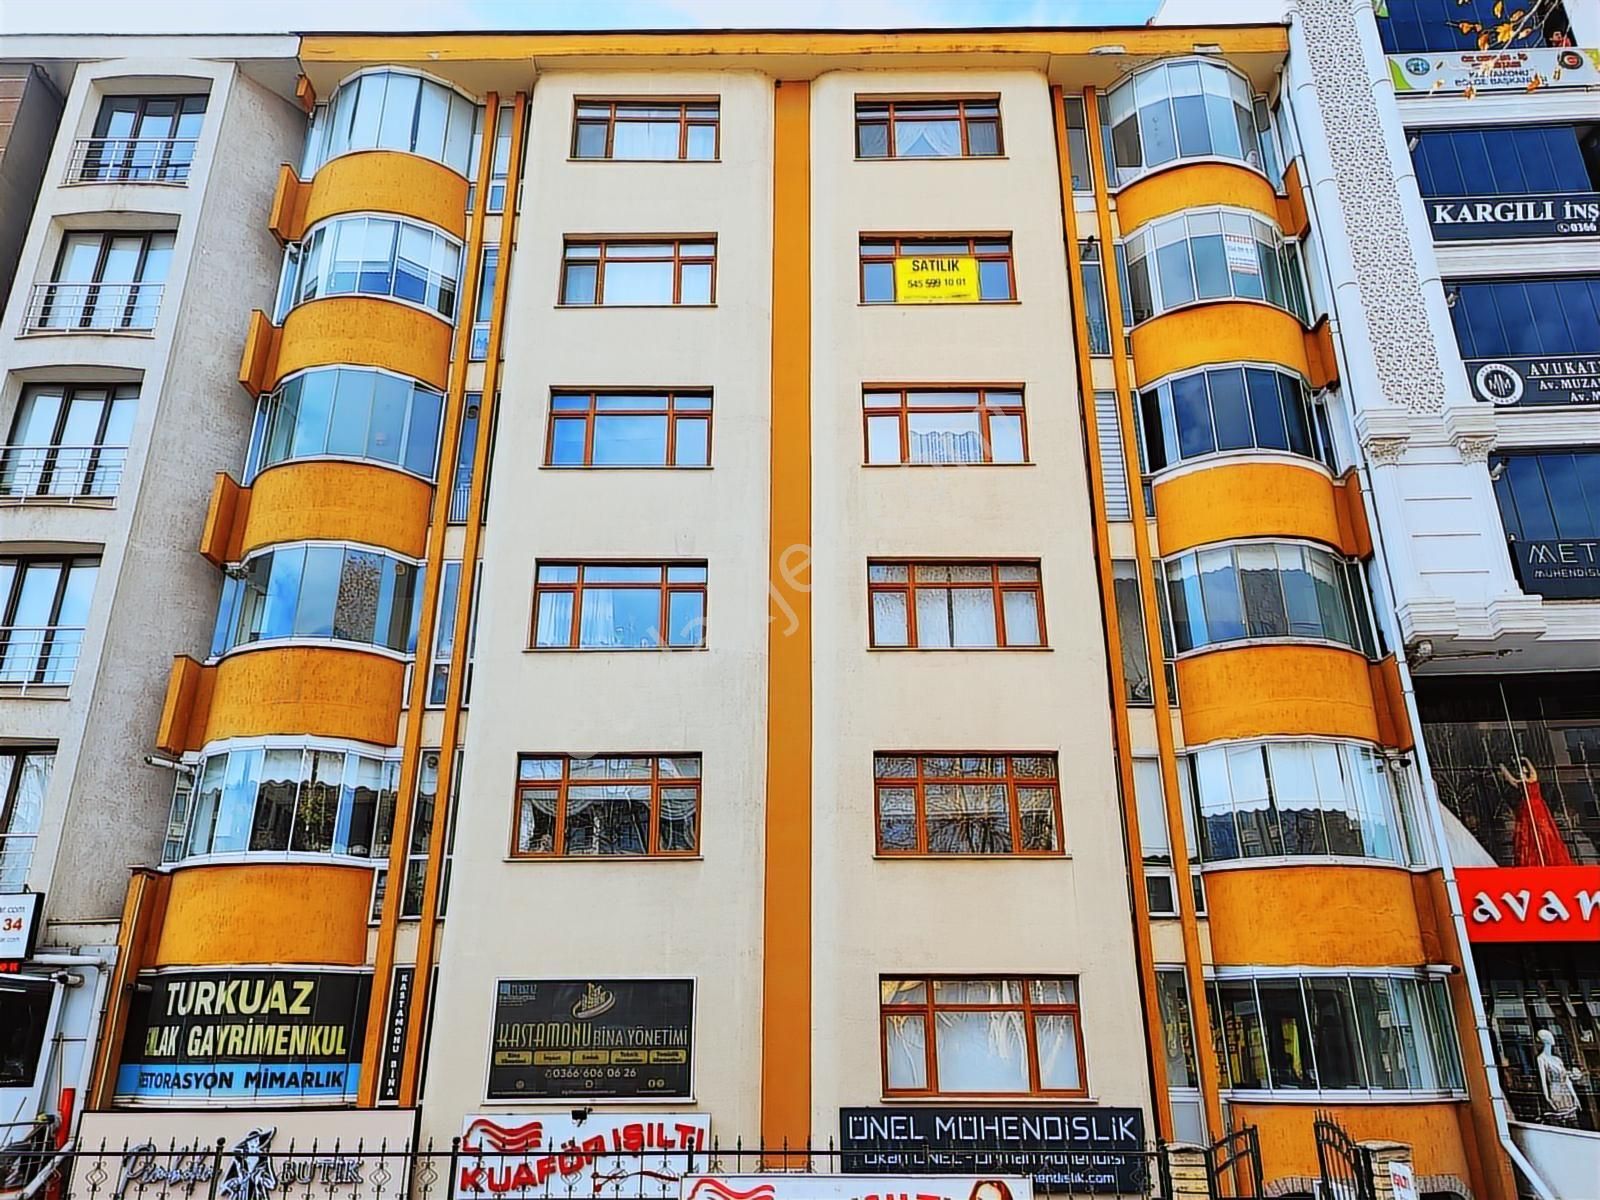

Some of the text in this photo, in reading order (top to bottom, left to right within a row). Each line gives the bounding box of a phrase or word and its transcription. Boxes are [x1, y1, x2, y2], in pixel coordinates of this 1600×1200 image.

[1434, 202, 1554, 224] KARGILI
[912, 260, 959, 272] SATILIK
[944, 278, 953, 286] 10
[956, 278, 966, 286] 01
[3, 918, 22, 931] 34
[166, 980, 314, 1016] TURKUAZ
[392, 974, 408, 1052] KASTAMONU
[187, 1018, 346, 1056] GAYRİMENKUL
[497, 1022, 687, 1048] KASTAMONU BİNA YÖNETİMİ
[244, 1068, 344, 1089] MİMARLIK
[553, 1068, 636, 1078] 0366 606 06 26
[849, 1116, 924, 1140] ÜNEL
